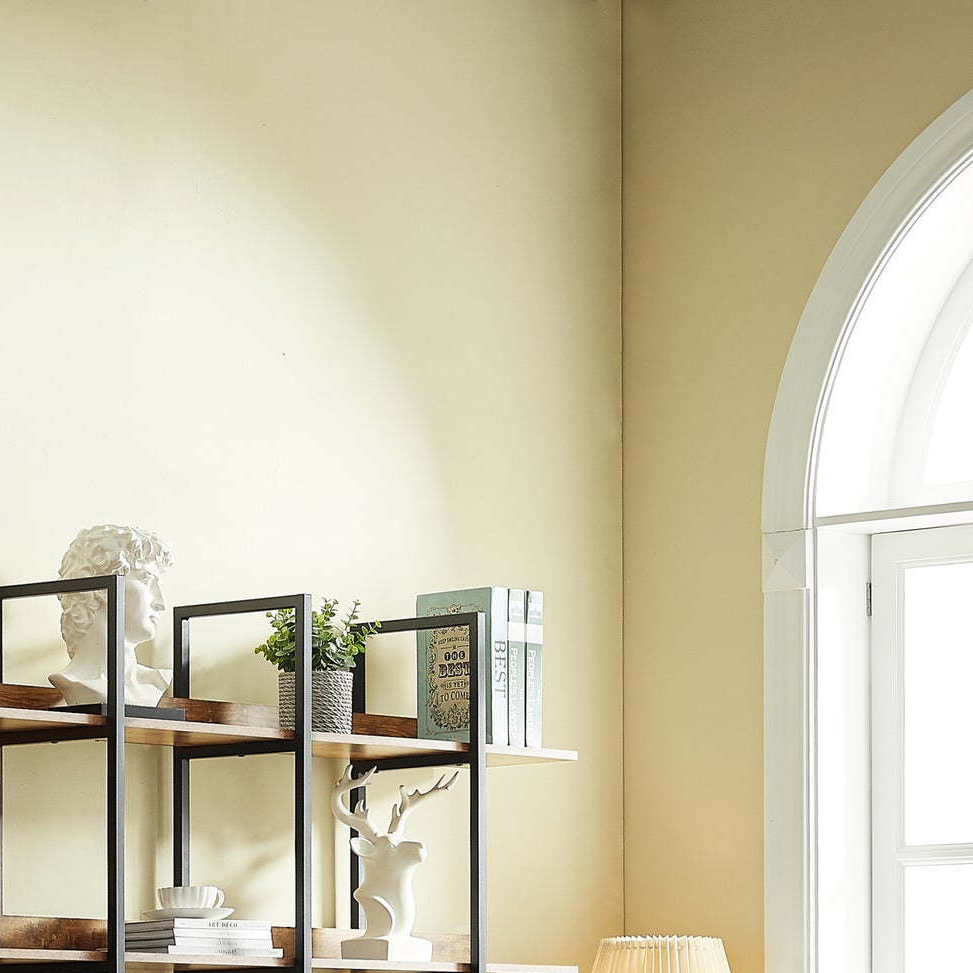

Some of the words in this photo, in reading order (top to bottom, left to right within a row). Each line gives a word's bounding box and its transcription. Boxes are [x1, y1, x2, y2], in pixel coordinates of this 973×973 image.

[444, 650, 466, 661] THE
[438, 662, 470, 678] BEST
[494, 640, 506, 697] BEST
[454, 680, 464, 688] YET
[440, 692, 450, 702] TO
[451, 691, 470, 701] COME
